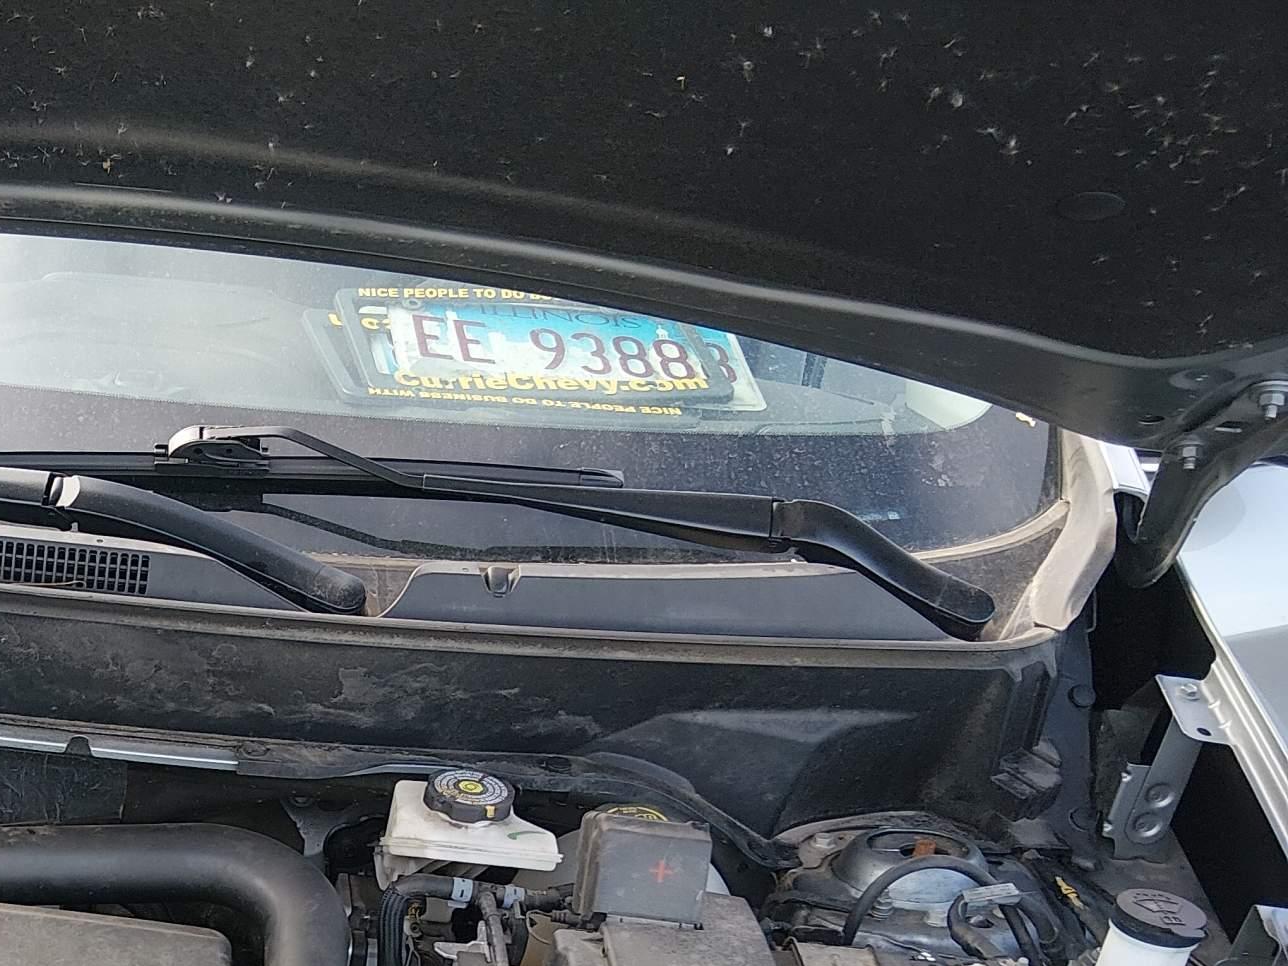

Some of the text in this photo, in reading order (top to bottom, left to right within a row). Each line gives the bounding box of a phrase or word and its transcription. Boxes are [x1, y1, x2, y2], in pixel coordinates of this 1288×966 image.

[358, 287, 399, 298] NICE
[404, 288, 469, 299] PEOPLE
[473, 288, 496, 299] TO
[501, 289, 525, 300] DO
[479, 303, 643, 329] ILLINOIS
[412, 314, 496, 366] EE
[529, 328, 696, 380] 9388
[394, 368, 710, 395] CurrieChevy.com
[568, 401, 637, 413] PEOPLE
[641, 406, 683, 416] NICE
